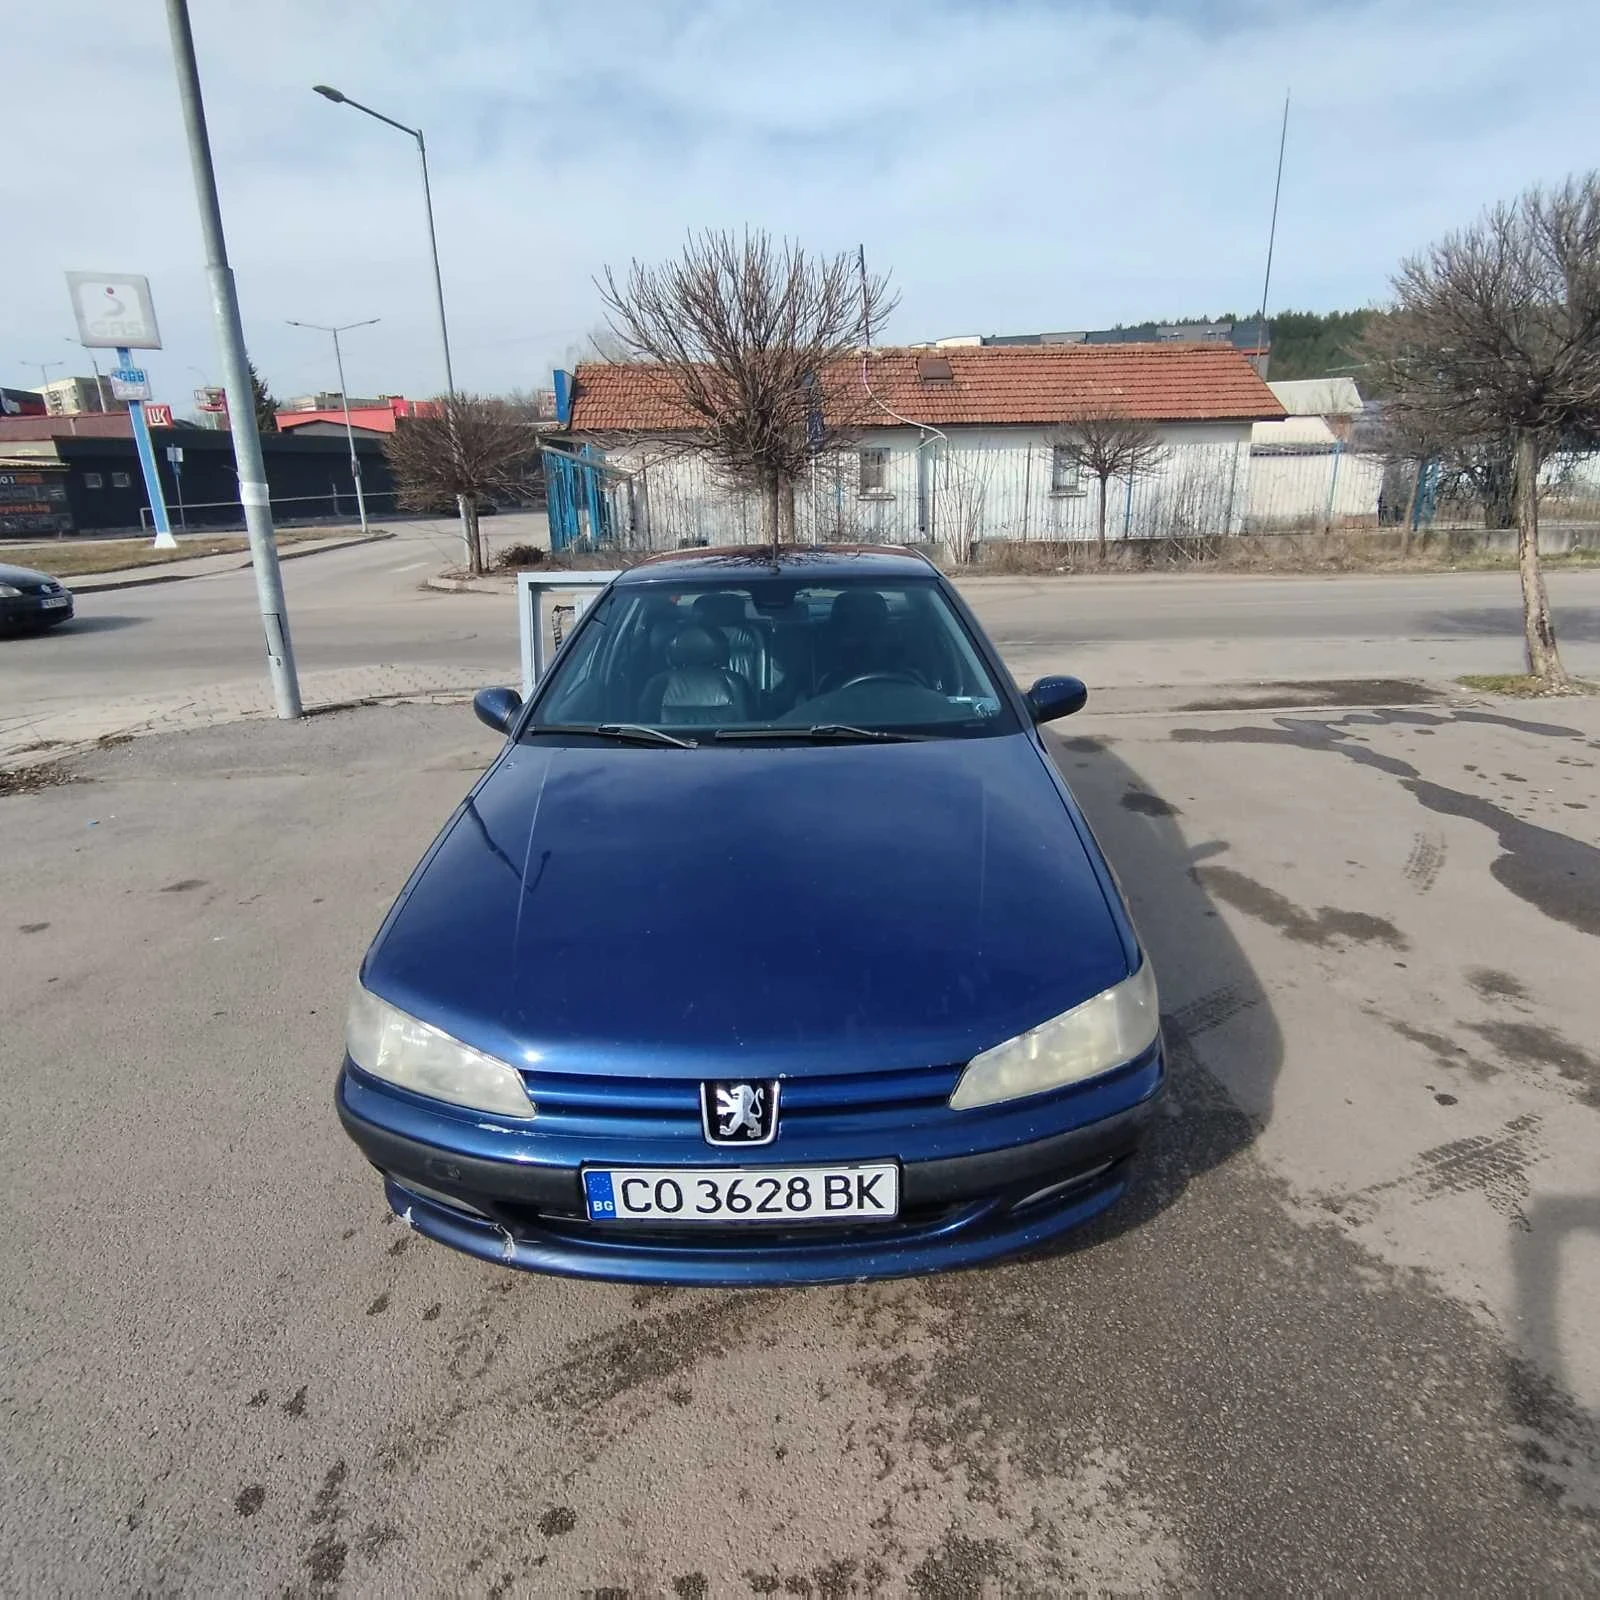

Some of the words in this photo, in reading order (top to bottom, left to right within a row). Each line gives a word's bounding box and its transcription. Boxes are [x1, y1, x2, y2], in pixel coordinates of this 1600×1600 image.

[593, 1200, 614, 1212] BG
[695, 1176, 812, 1214] 3628
[824, 1173, 885, 1211] BK
